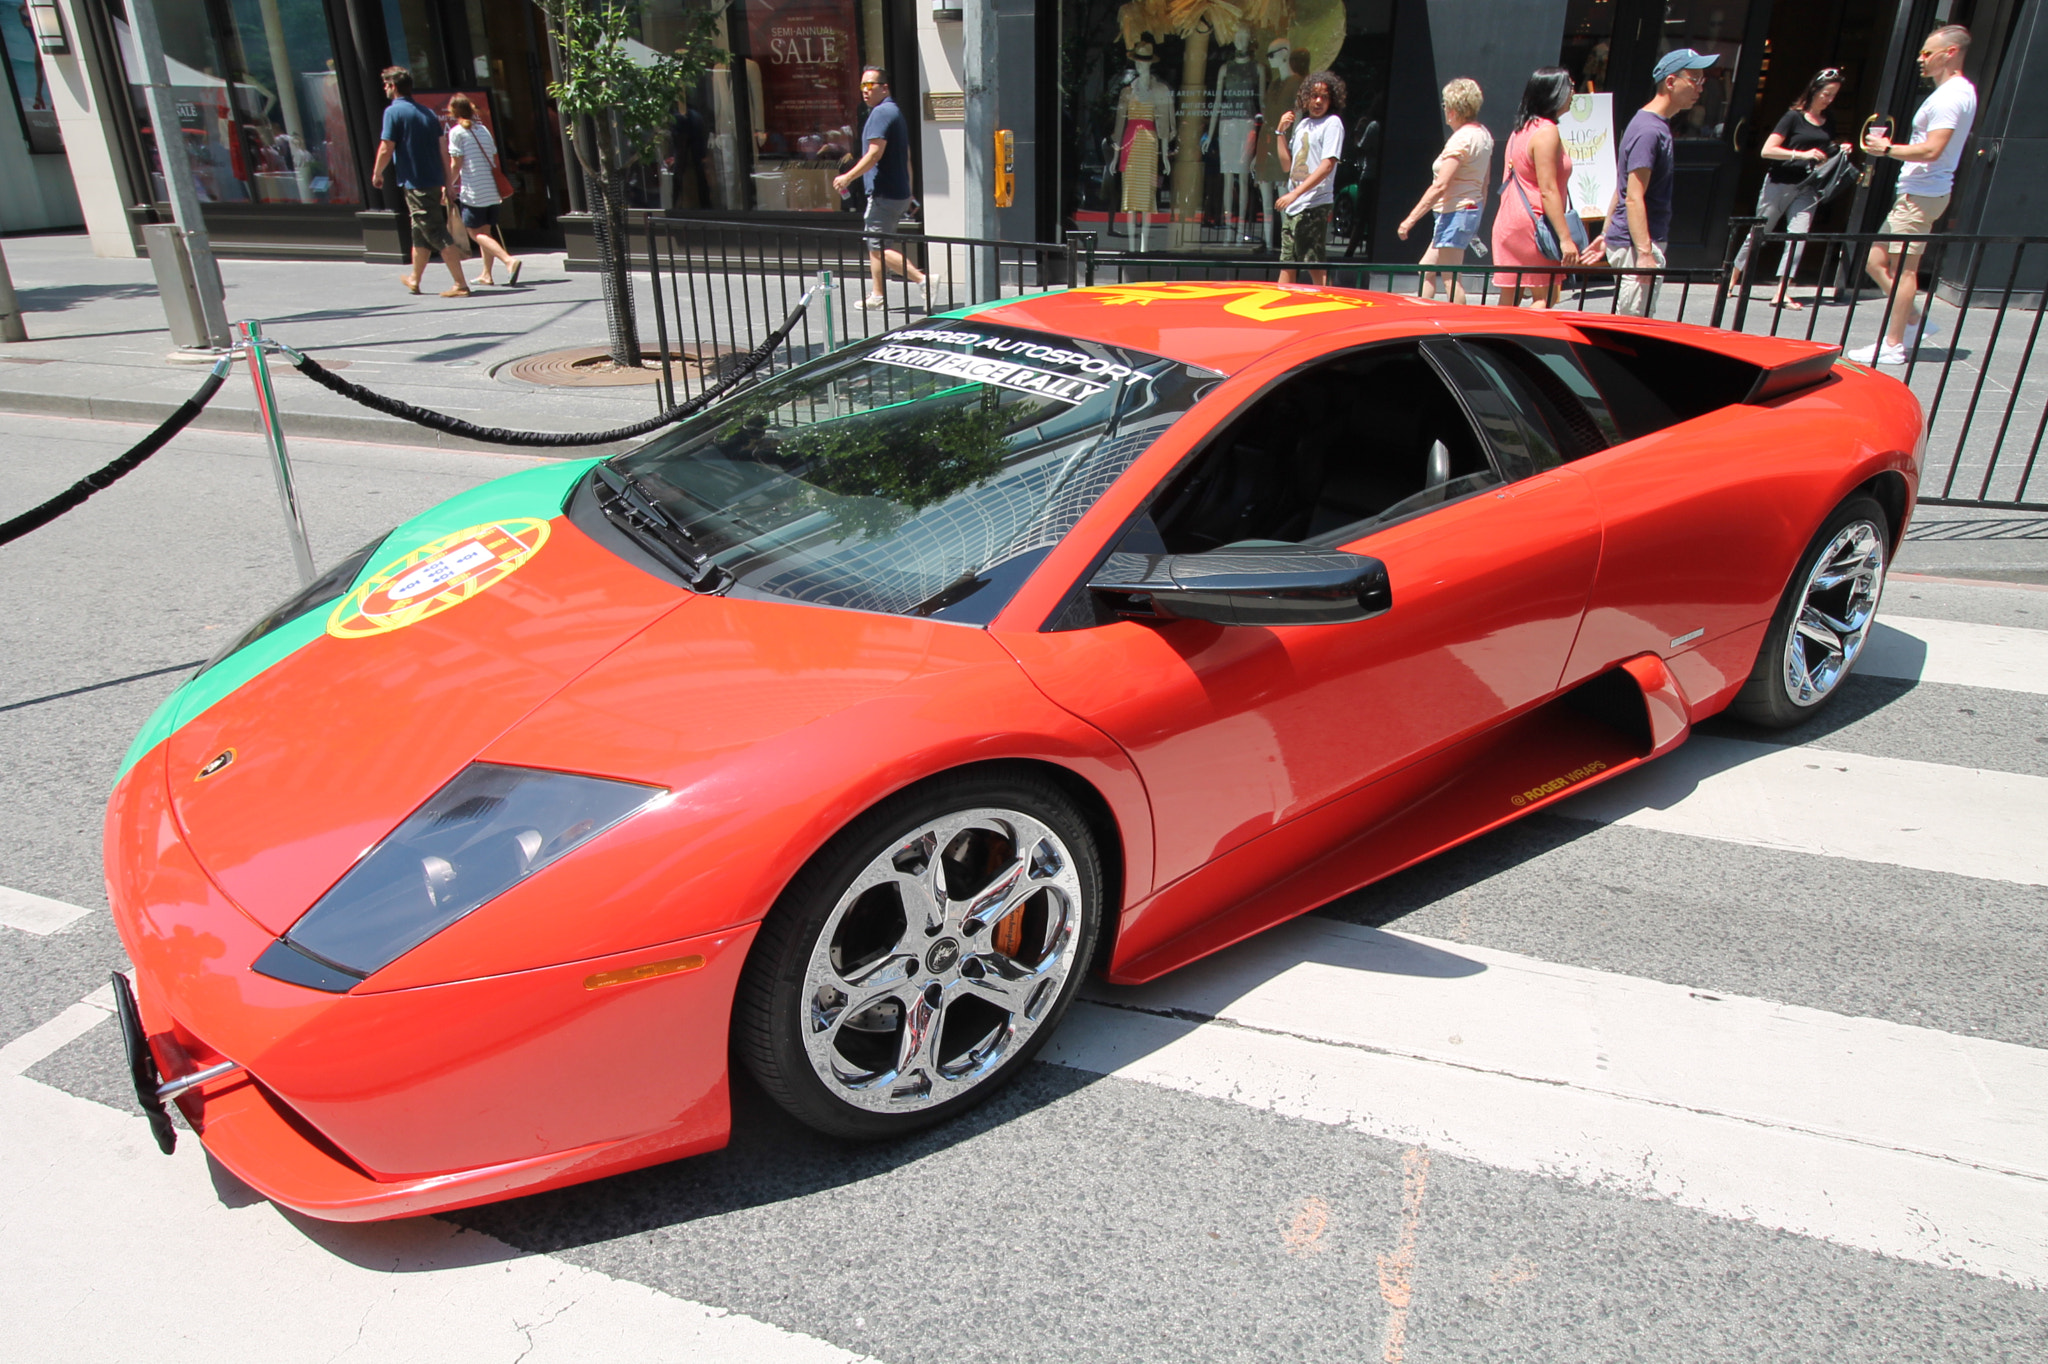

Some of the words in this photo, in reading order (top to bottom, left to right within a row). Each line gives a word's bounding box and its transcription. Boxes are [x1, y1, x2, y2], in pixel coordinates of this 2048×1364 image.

[771, 26, 835, 37] SEMI-ANNUAL
[770, 37, 839, 64] SALE
[1567, 128, 1599, 146] 40%
[1567, 145, 1598, 162] OFF
[867, 346, 945, 367] NORTH
[940, 355, 1012, 381] FACE
[1005, 369, 1105, 400] RALLY
[974, 337, 1153, 386] AUTOSPORT
[1511, 795, 1526, 806] @
[1523, 777, 1570, 801] ROGER
[1564, 760, 1607, 782] WRAPS
